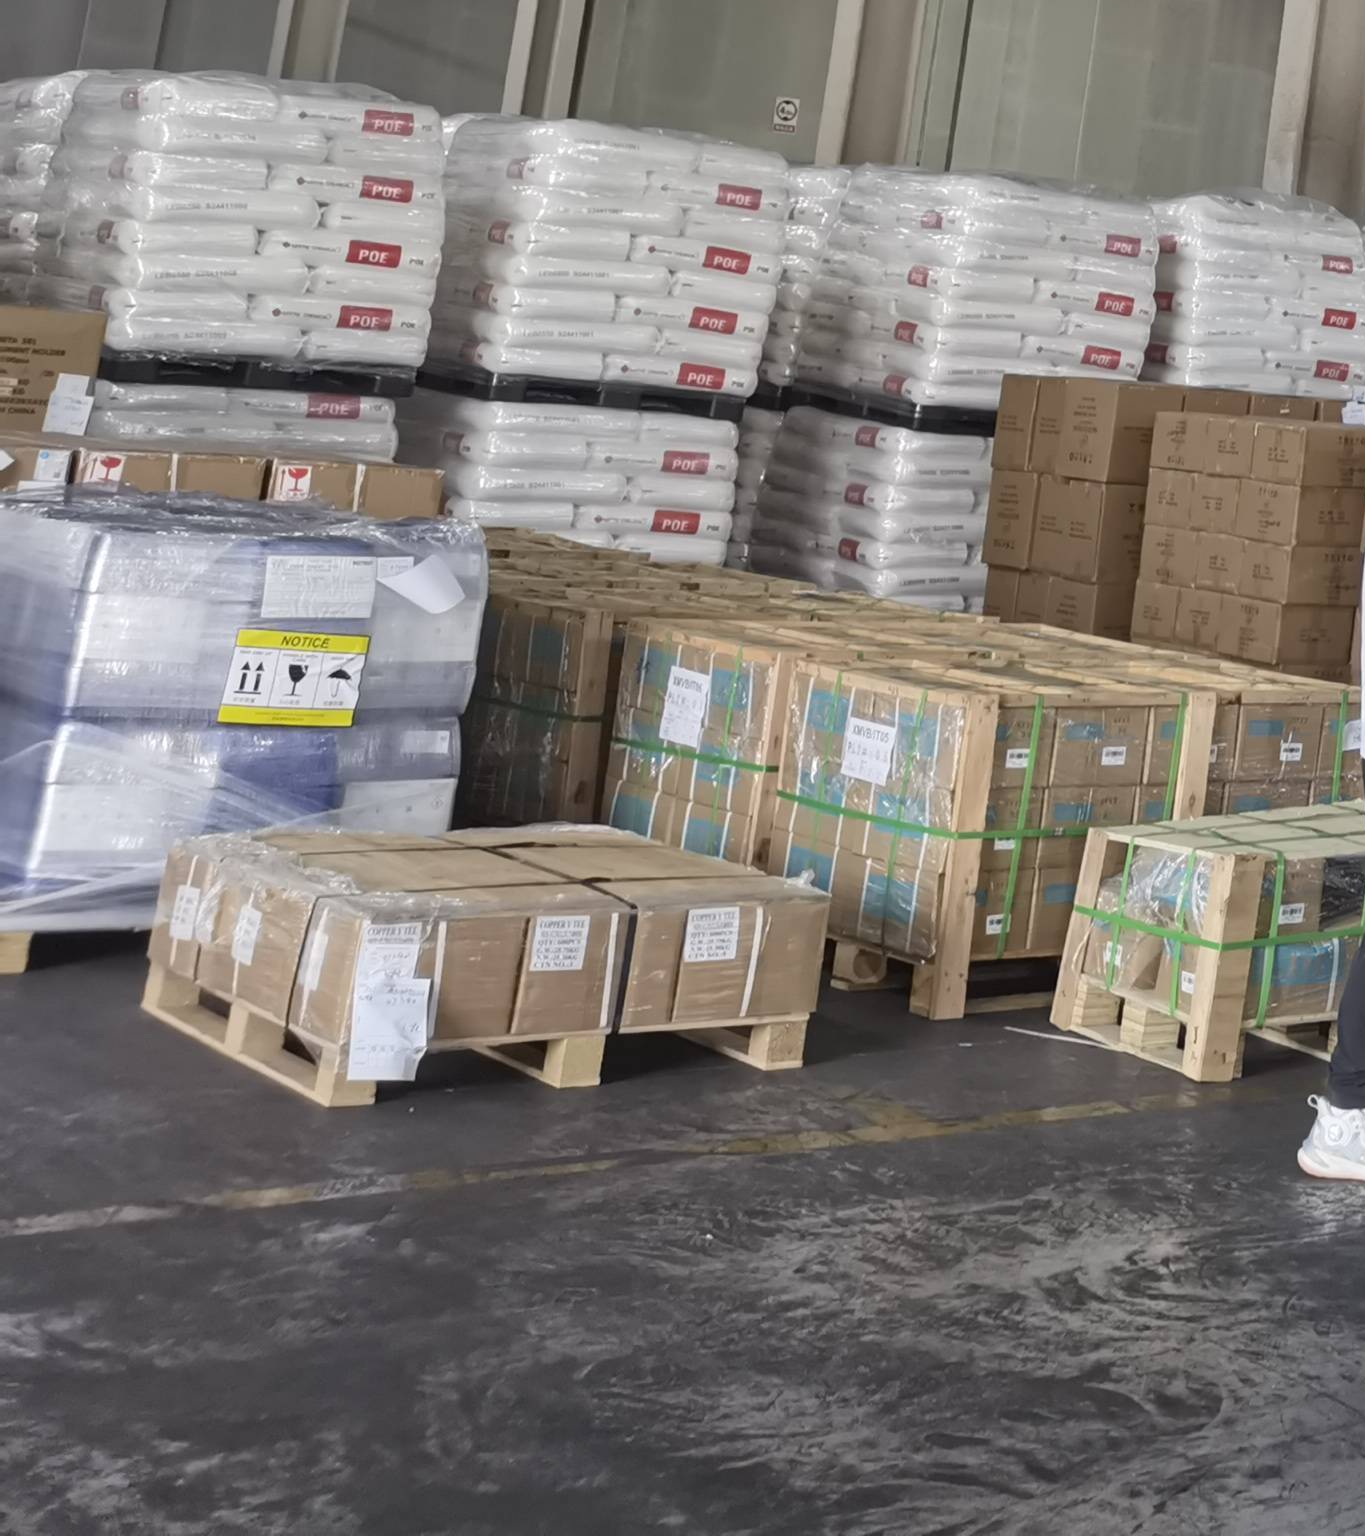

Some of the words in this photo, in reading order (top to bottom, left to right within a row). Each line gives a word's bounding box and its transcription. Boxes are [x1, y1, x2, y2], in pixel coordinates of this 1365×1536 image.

[374, 119, 403, 133] POE
[371, 185, 401, 198] POE
[726, 192, 752, 206] POE
[358, 249, 390, 264] POE
[713, 255, 740, 270] POE
[1105, 299, 1127, 313] POE
[350, 314, 381, 329] POE
[699, 316, 727, 330] POE
[1329, 316, 1348, 327] POE
[1090, 353, 1113, 367] POE
[687, 372, 715, 386] POE
[1321, 368, 1341, 378] POE
[672, 459, 699, 472] POE
[662, 519, 690, 532] POE
[280, 635, 331, 650] NOTICE
[367, 926, 397, 937] COPPER
